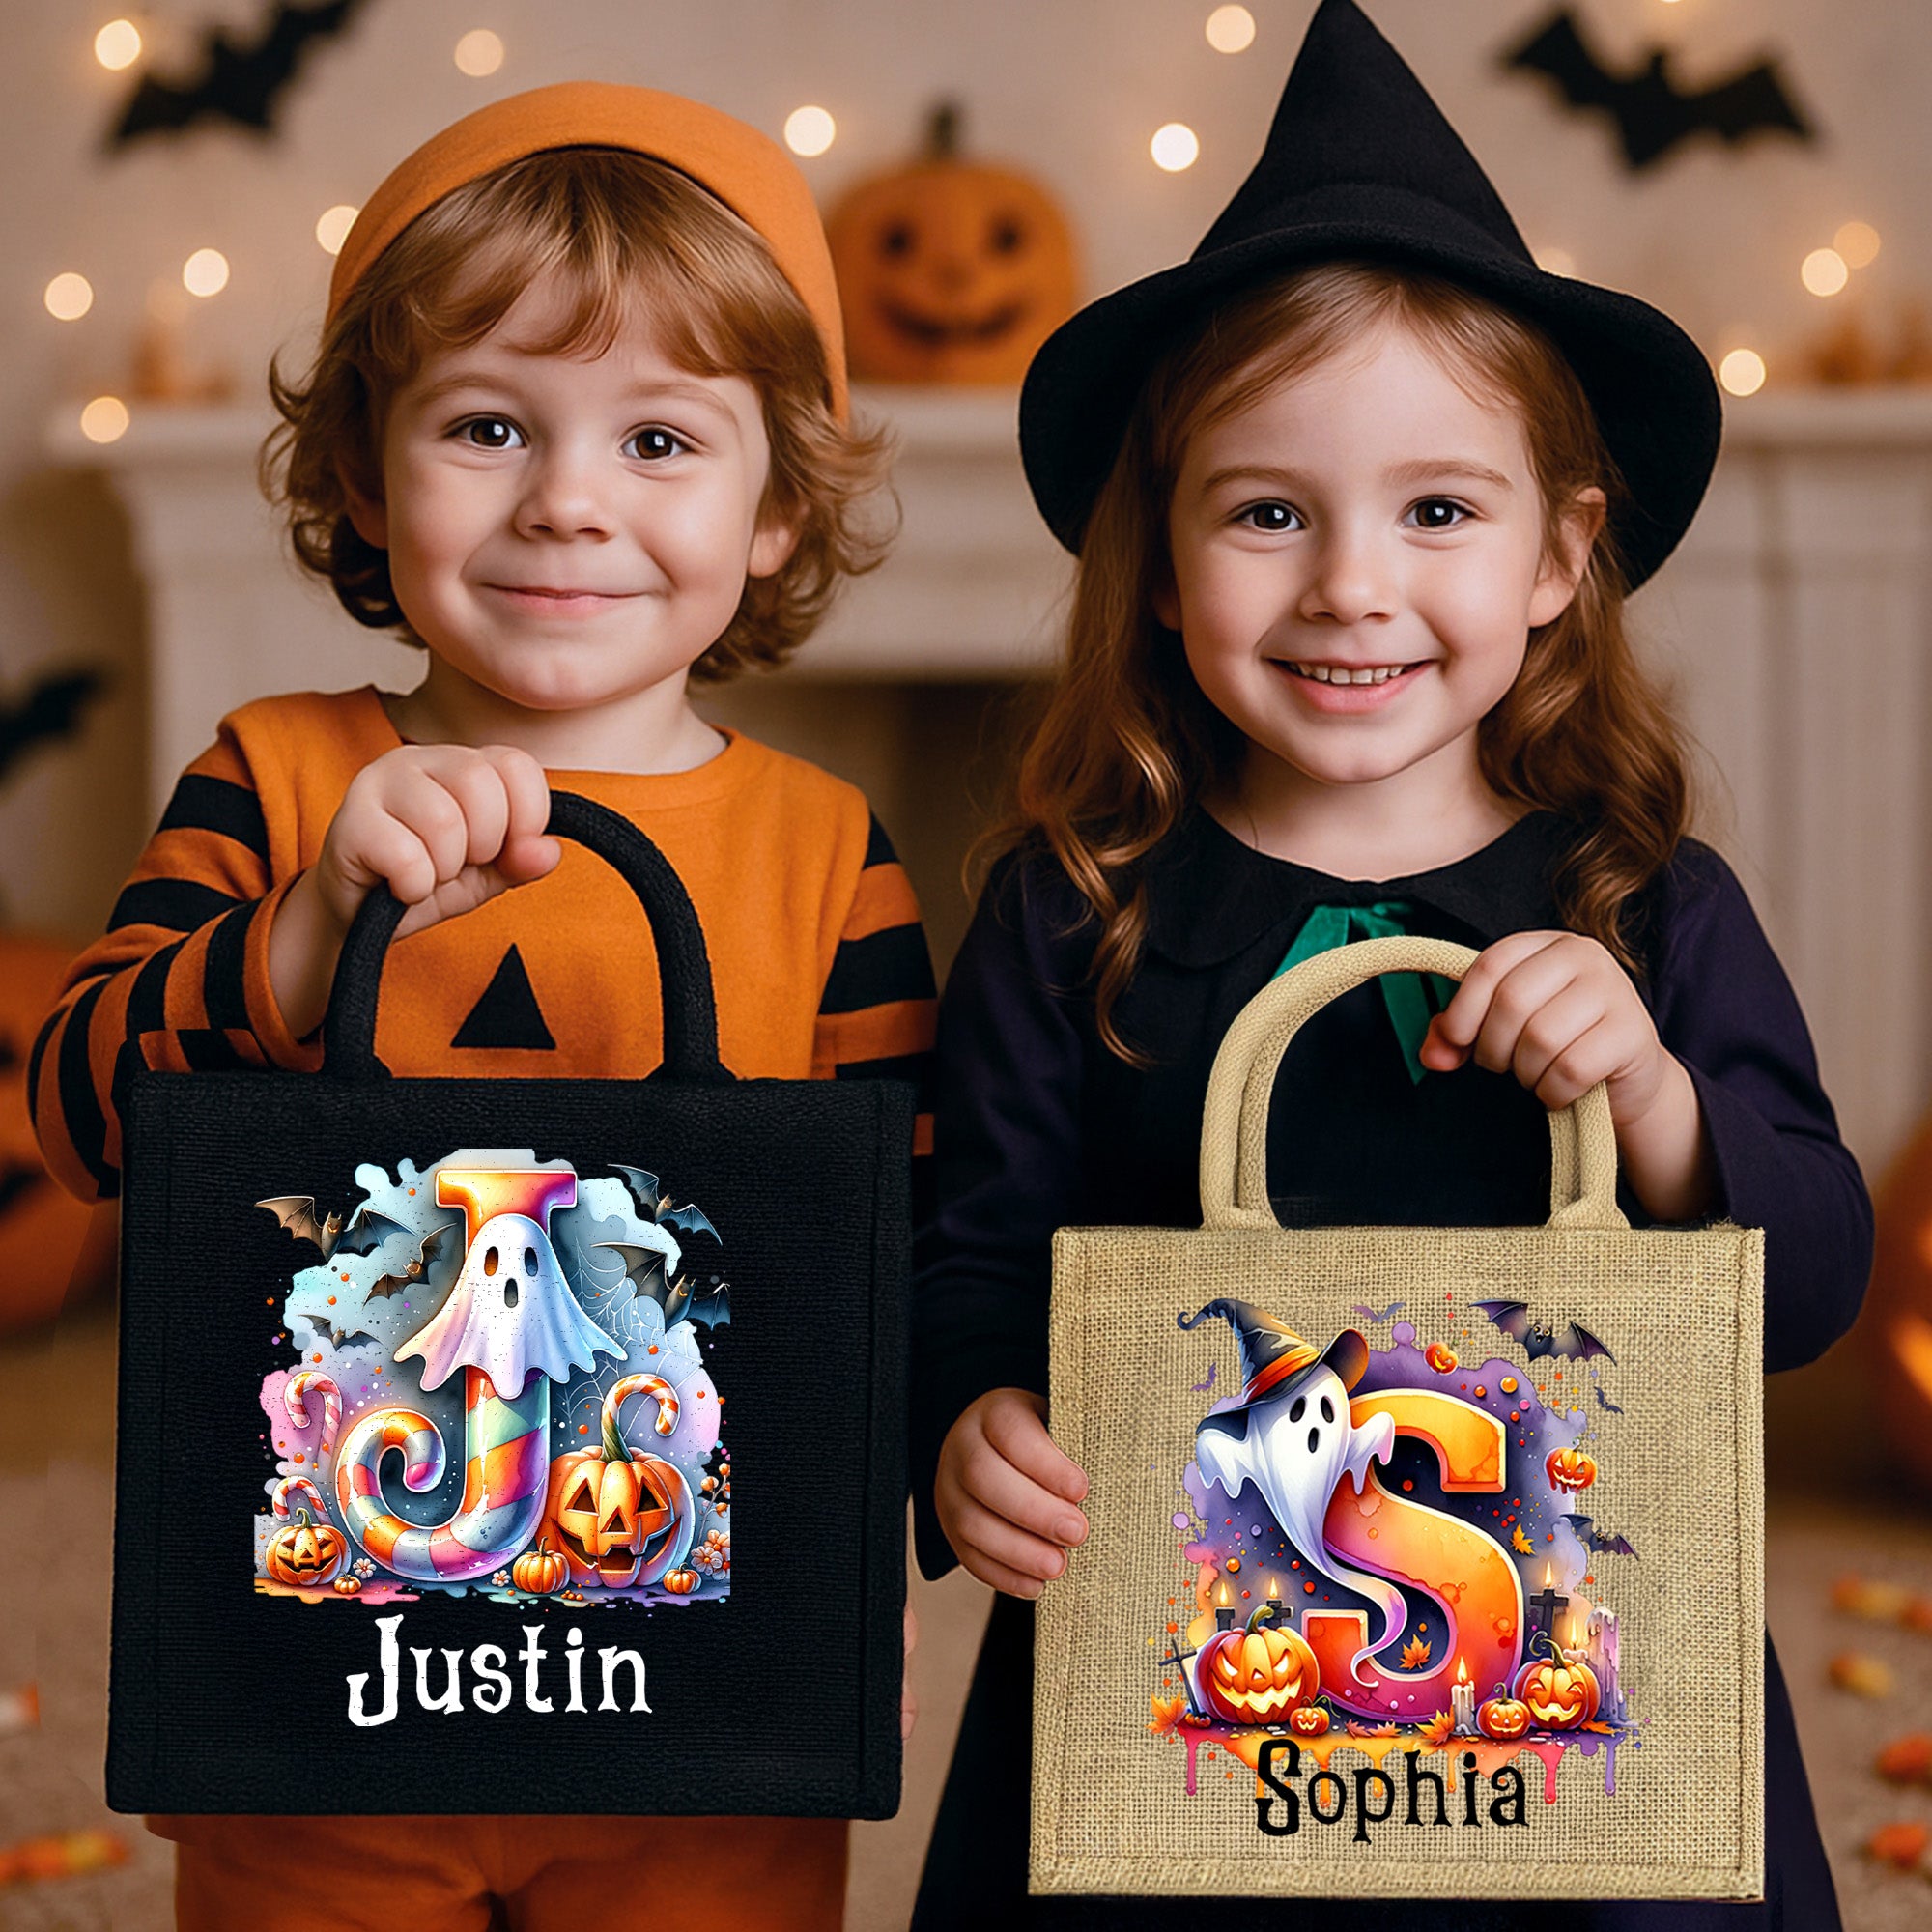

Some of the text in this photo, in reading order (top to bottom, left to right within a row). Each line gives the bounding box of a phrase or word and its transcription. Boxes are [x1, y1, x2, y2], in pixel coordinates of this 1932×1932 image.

[335, 1169, 578, 1582] J
[1301, 1388, 1523, 1722] S
[346, 1614, 653, 1727] Justin
[1255, 1738, 1530, 1846] Sophia
